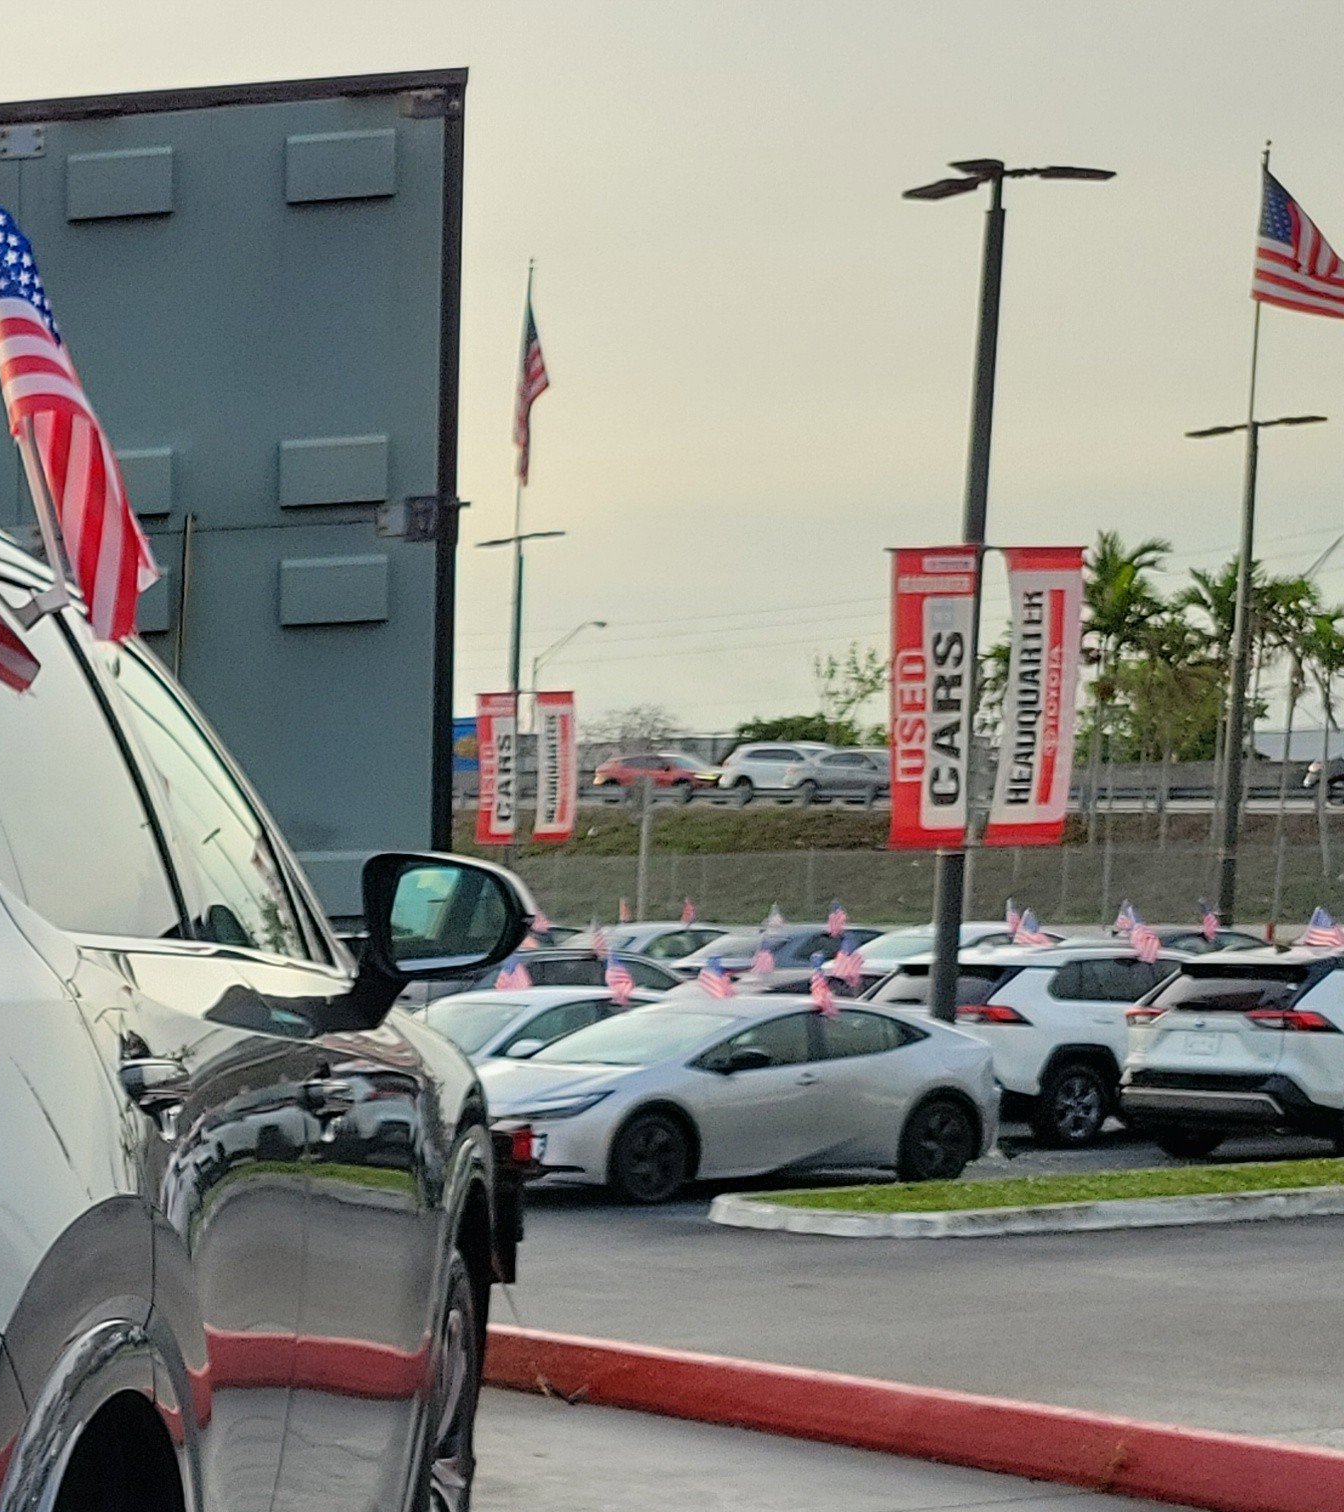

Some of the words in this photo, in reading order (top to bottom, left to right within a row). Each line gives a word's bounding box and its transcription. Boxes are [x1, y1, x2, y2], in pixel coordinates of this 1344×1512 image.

[894, 651, 928, 783] USED
[929, 631, 965, 806] CARS
[1004, 590, 1043, 805] HEADQUARTER
[497, 734, 512, 823] CARS
